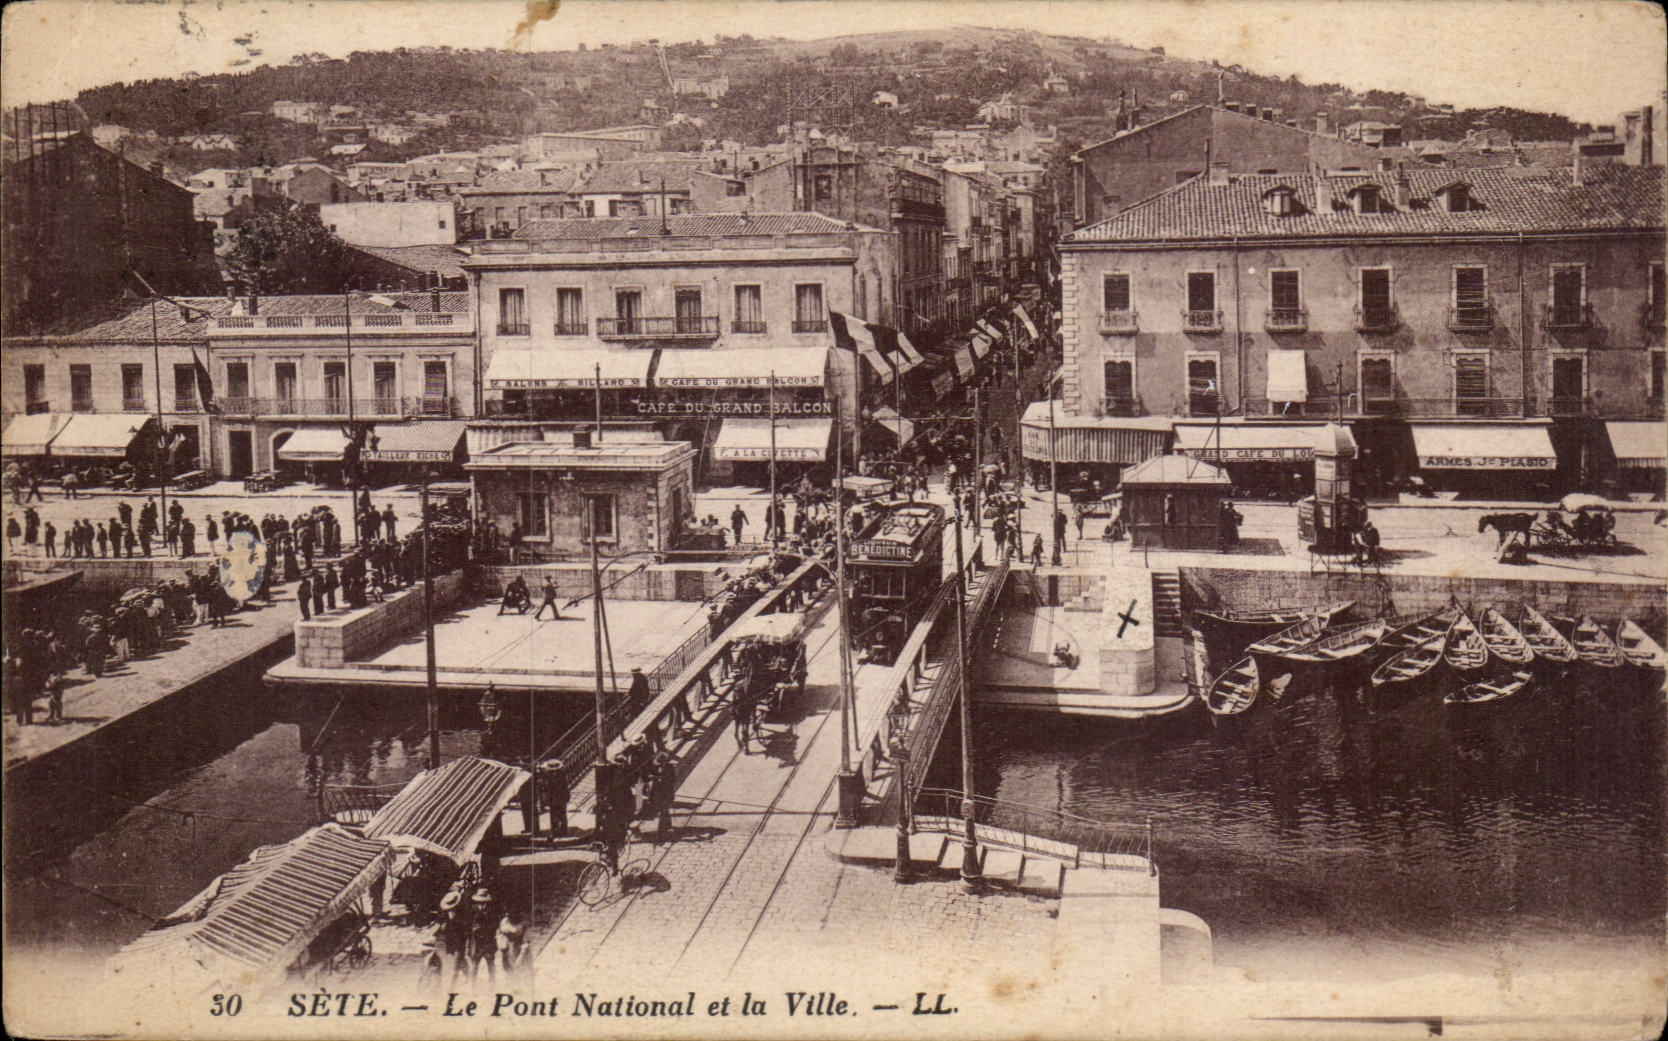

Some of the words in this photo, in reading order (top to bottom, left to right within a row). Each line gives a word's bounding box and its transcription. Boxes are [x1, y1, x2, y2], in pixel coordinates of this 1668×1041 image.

[506, 380, 547, 388] SALONS
[578, 379, 624, 387] BILARD
[706, 378, 718, 386] DU
[725, 377, 760, 386] GRAND
[767, 377, 807, 386] BALCON
[685, 401, 704, 414] DU
[713, 401, 762, 414] GRAND
[743, 449, 757, 457] LA
[1271, 449, 1285, 458] DU
[1425, 456, 1473, 467] ARMES
